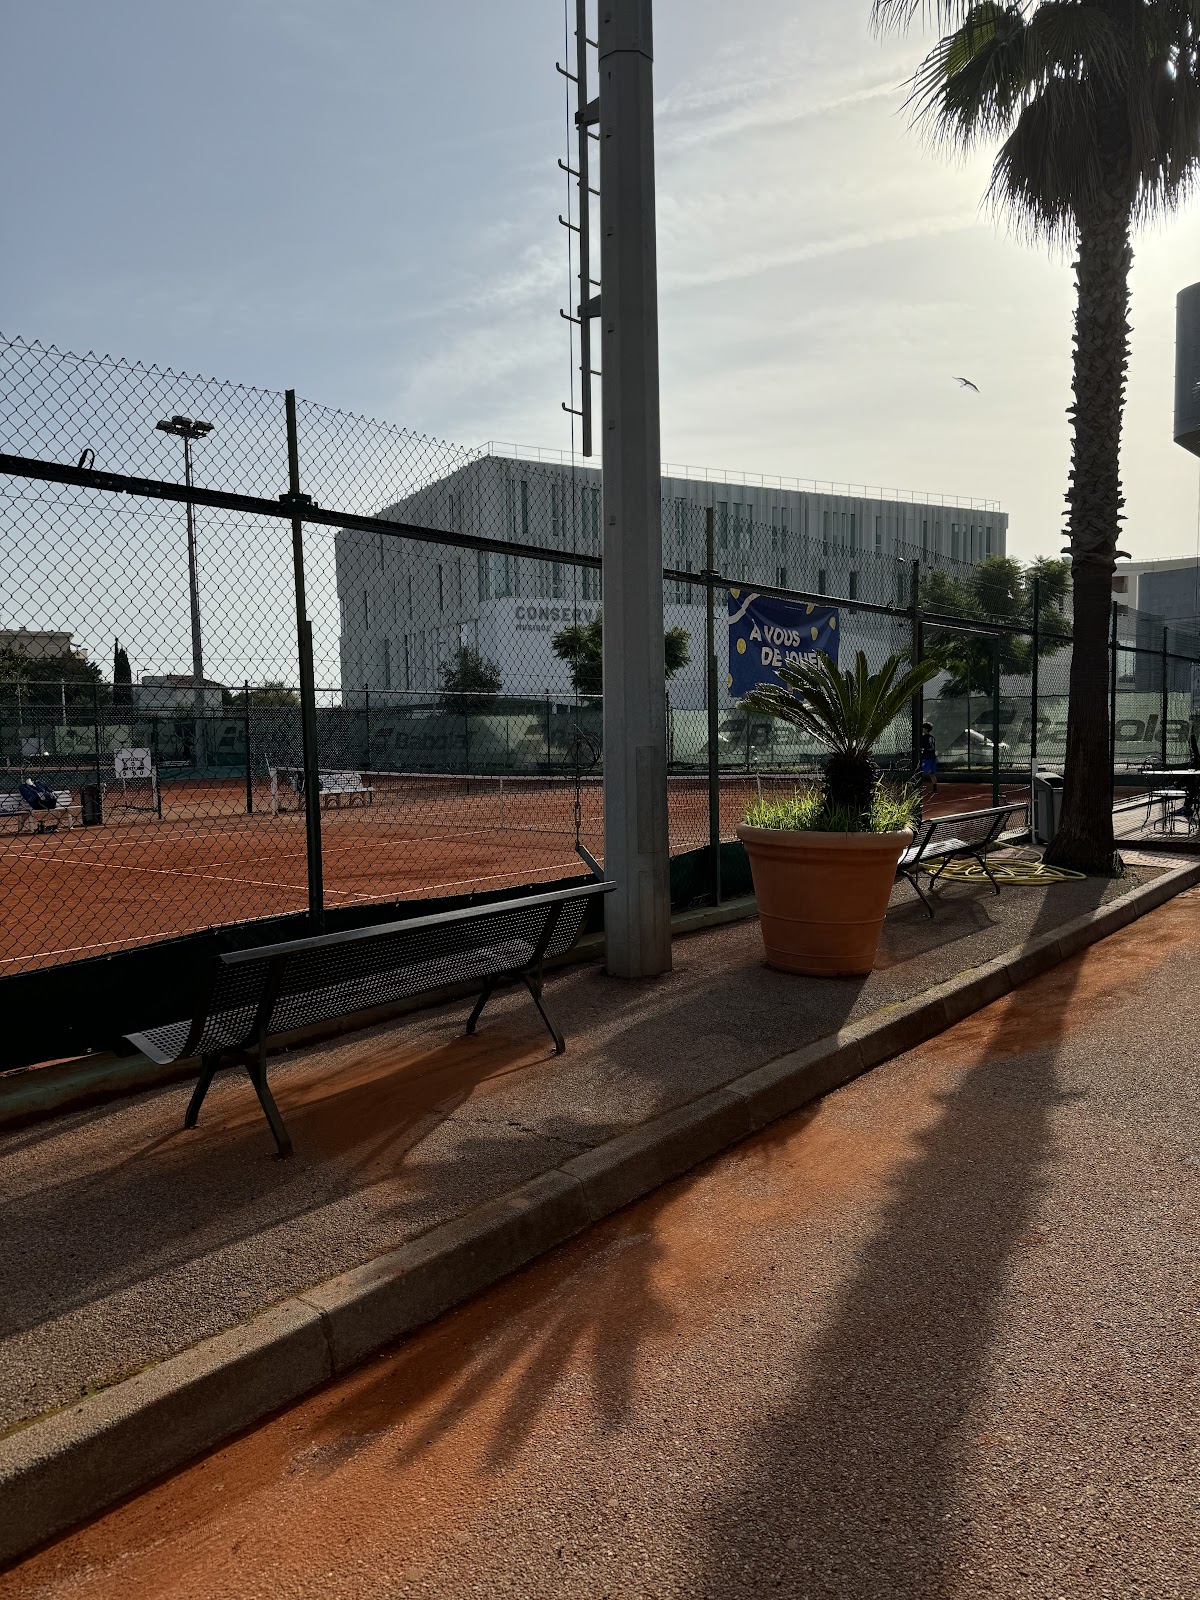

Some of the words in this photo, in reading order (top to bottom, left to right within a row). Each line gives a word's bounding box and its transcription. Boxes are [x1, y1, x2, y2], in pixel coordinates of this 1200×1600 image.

[515, 605, 603, 622] CONSERVA
[764, 625, 801, 647] VOUS
[761, 647, 783, 667] DE
